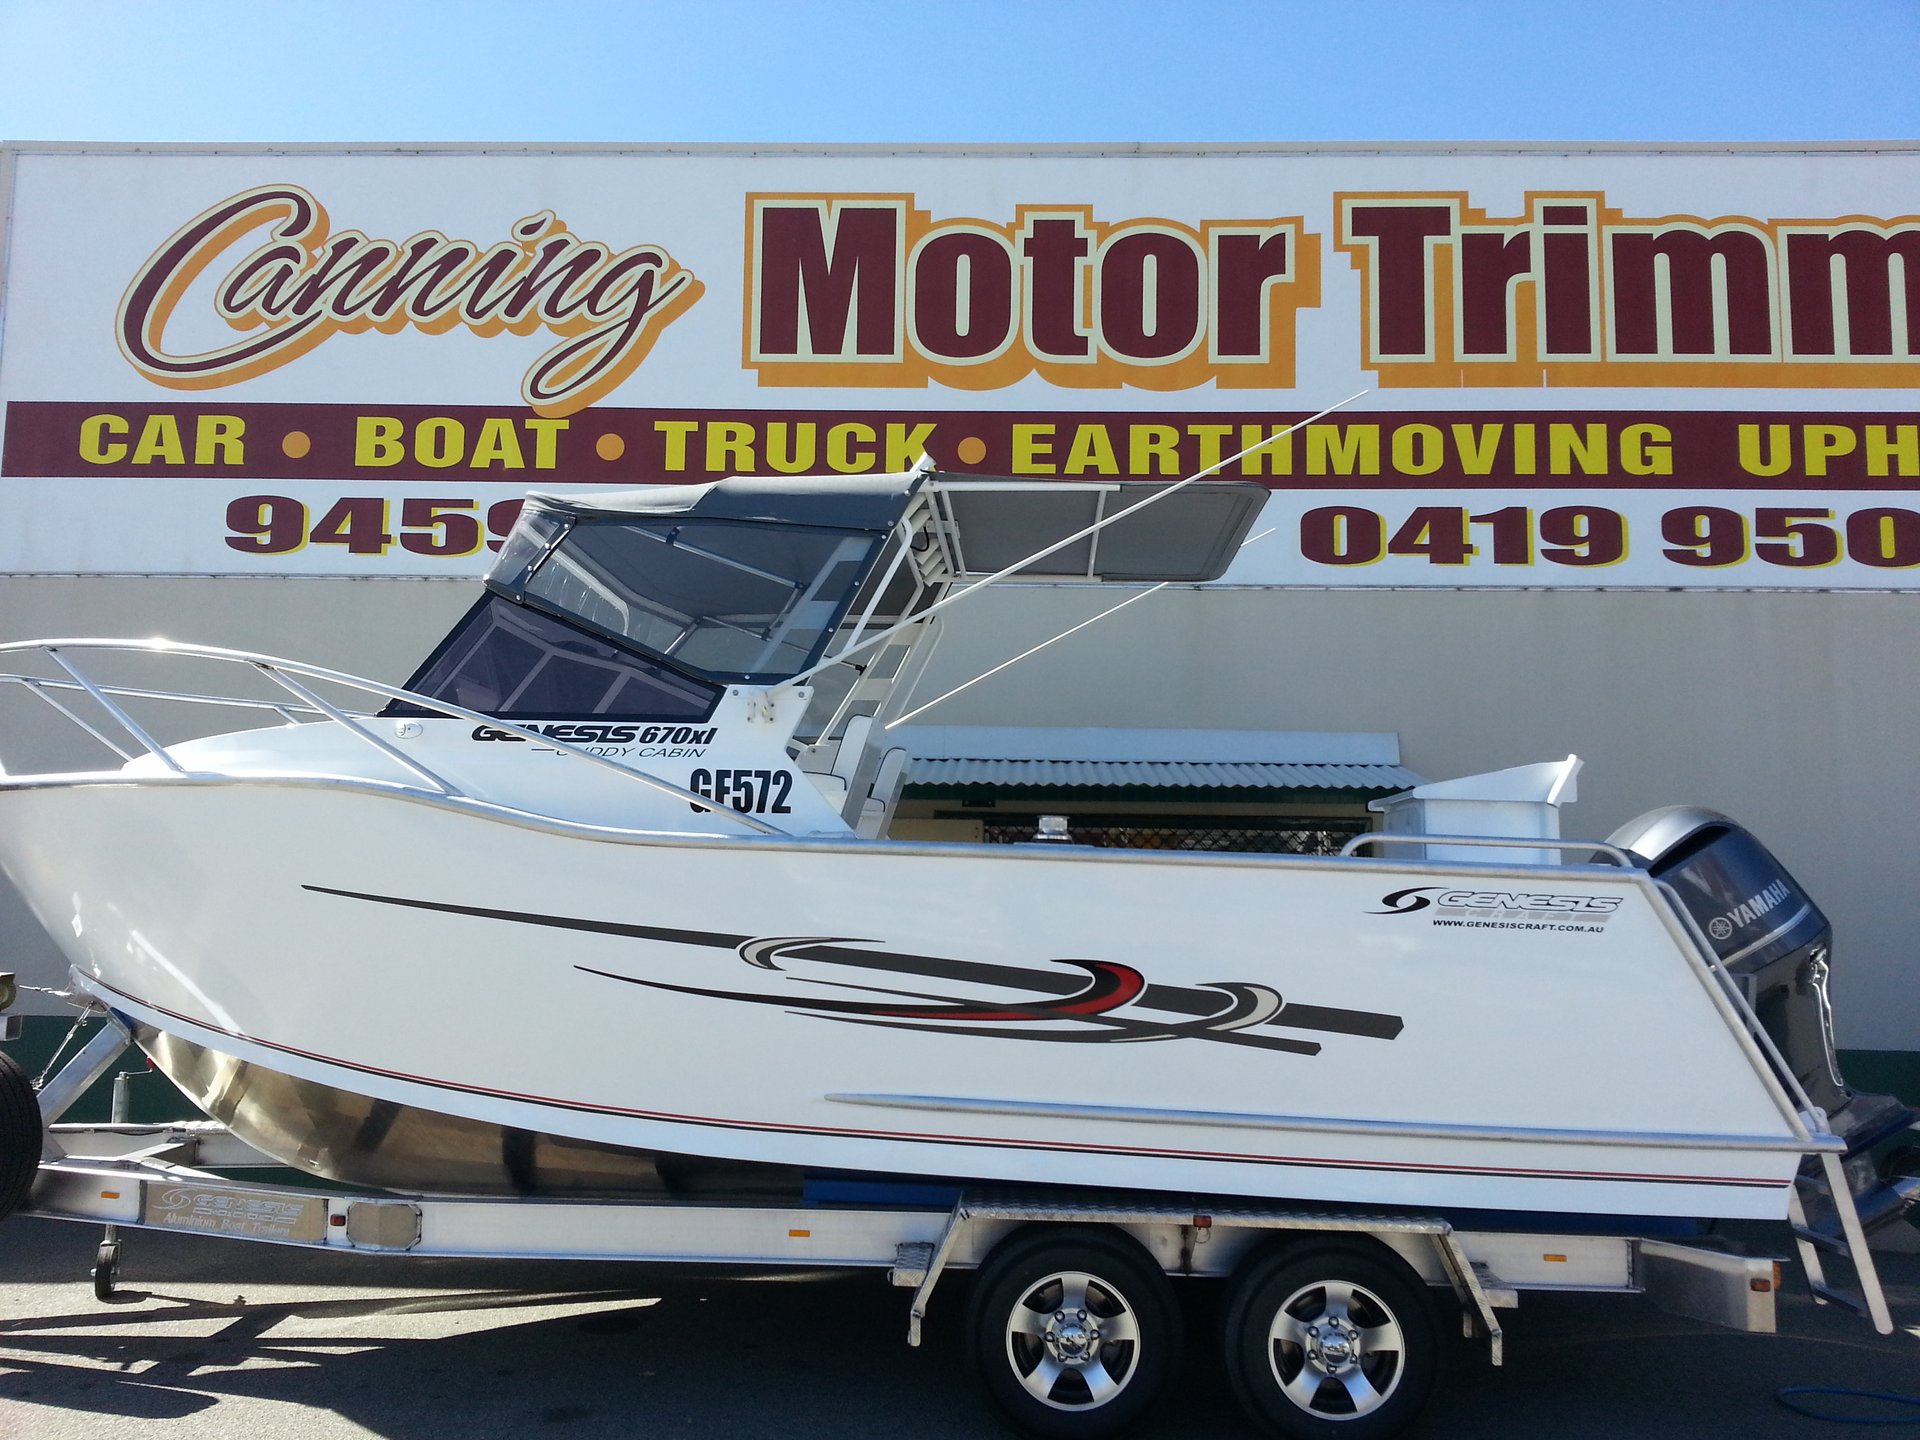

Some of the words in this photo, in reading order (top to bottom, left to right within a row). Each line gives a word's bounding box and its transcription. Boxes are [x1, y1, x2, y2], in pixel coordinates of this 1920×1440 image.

[116, 185, 700, 412] Canning
[748, 196, 1298, 370] Motor
[79, 414, 246, 466] CAR
[354, 416, 570, 470] BOAT
[653, 420, 938, 474] TRUCK
[1011, 422, 1673, 477] EARTHMOVING
[1738, 423, 1920, 477] UPH
[1300, 505, 1629, 567] 0419
[1660, 505, 1920, 568] 950
[637, 748, 707, 758] CABIN
[1437, 890, 1624, 913] GENESIS
[1726, 878, 1791, 929] YAMAHA
[1432, 919, 1605, 934] WWW.GENESISCRAFT.COM.AU
[164, 1212, 216, 1229] Aluminium
[221, 1219, 246, 1232] Boat
